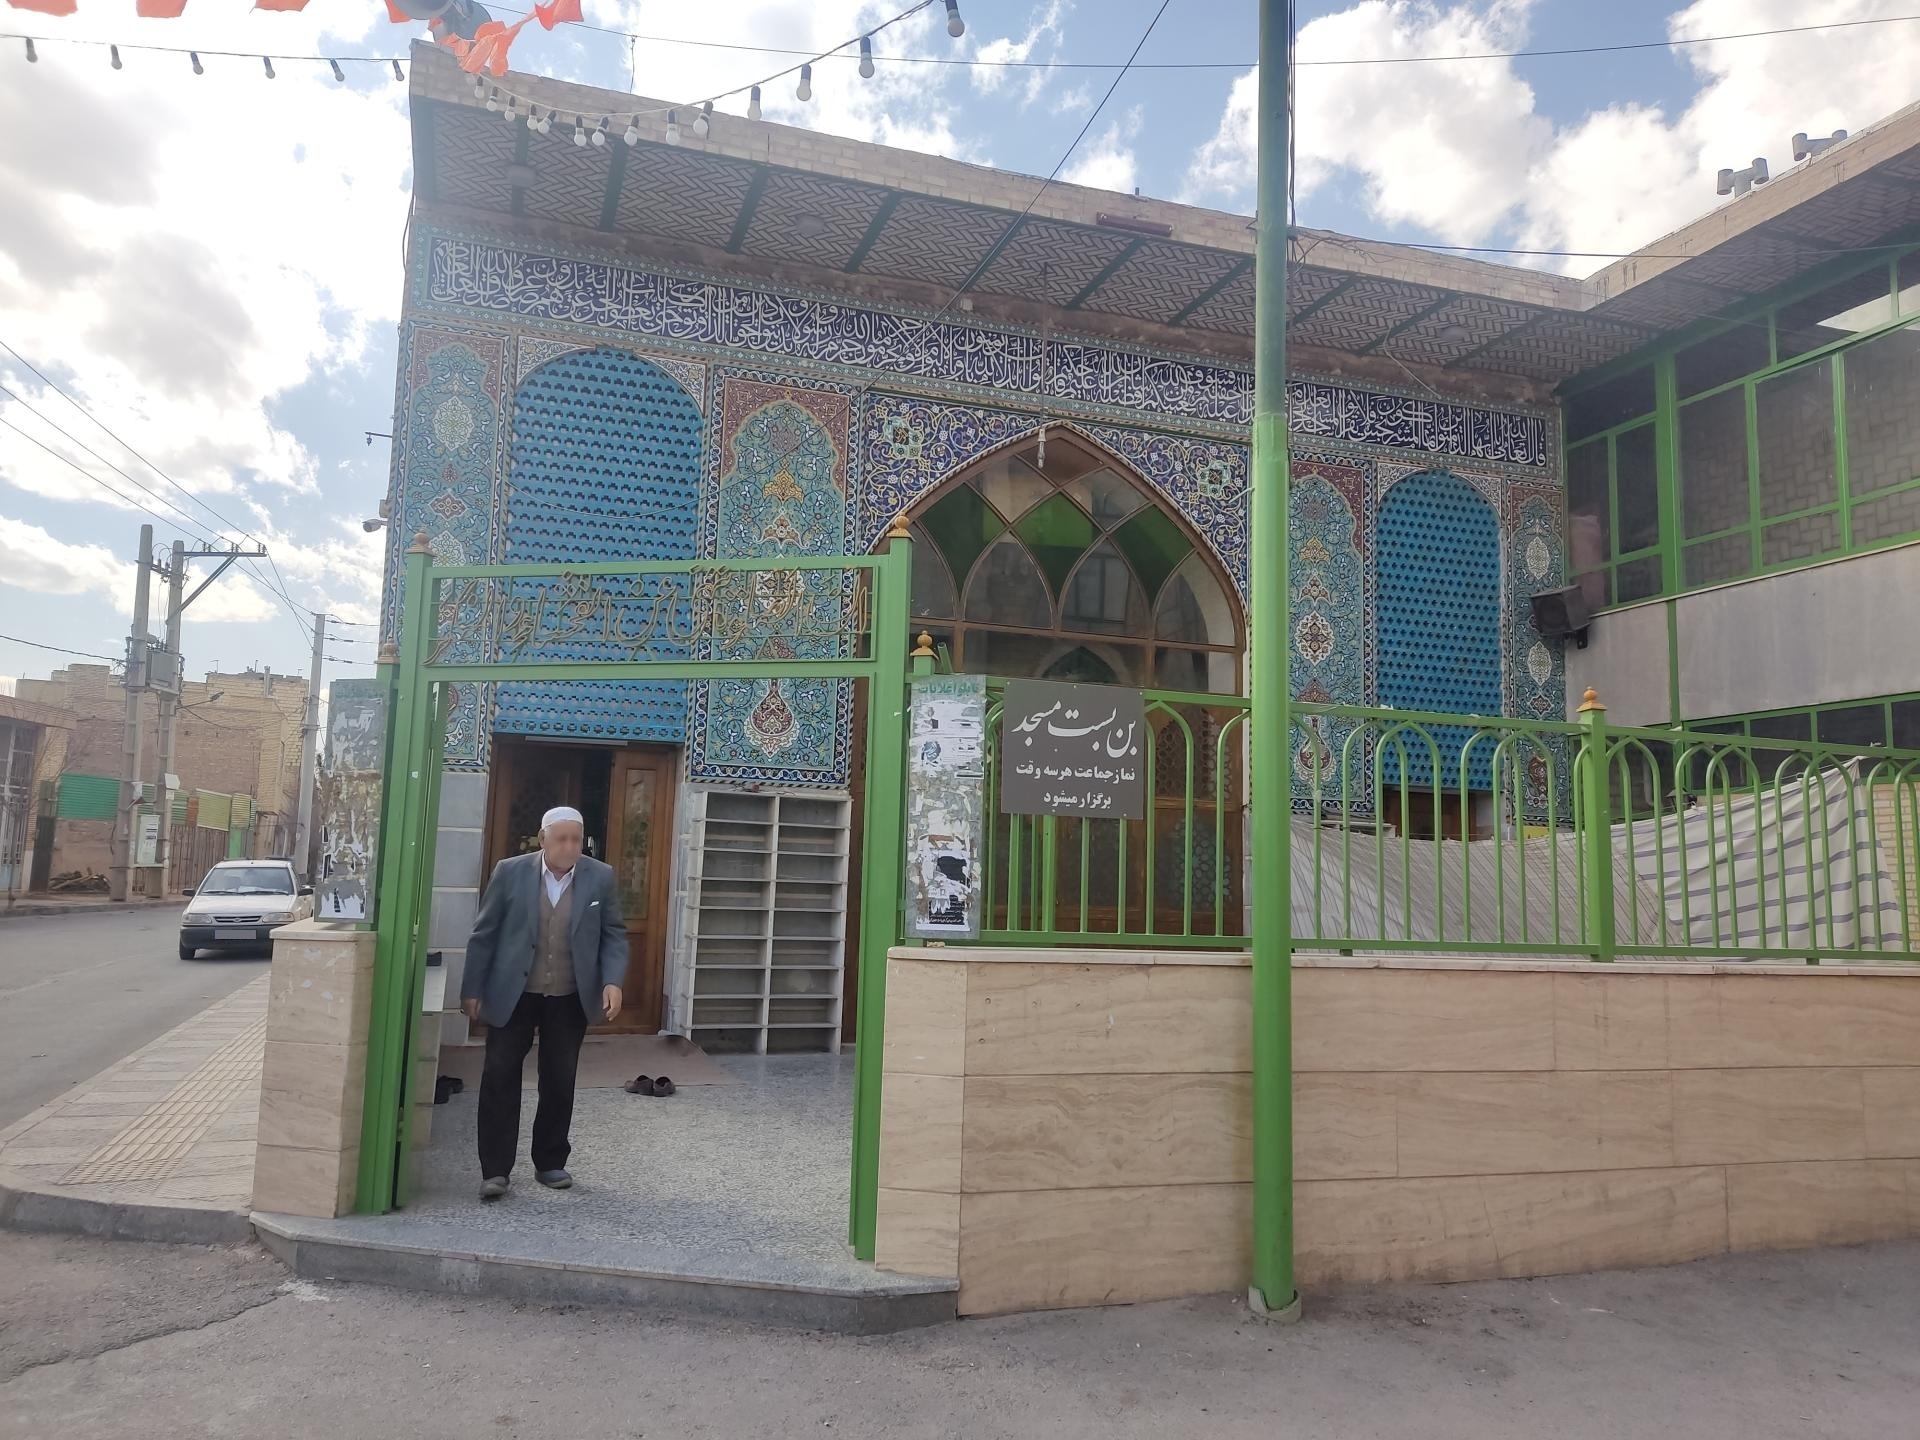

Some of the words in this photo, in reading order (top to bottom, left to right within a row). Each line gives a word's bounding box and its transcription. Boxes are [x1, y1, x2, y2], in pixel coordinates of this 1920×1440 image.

[1011, 700, 1062, 747] مسجد
[1047, 707, 1117, 751] بست
[1106, 719, 1138, 758] بن
[1016, 760, 1041, 779] وقت
[1074, 765, 1114, 783] جماعت
[1112, 767, 1136, 784] نماز
[1043, 790, 1077, 808] میشود
[1078, 791, 1112, 809] برگزار
